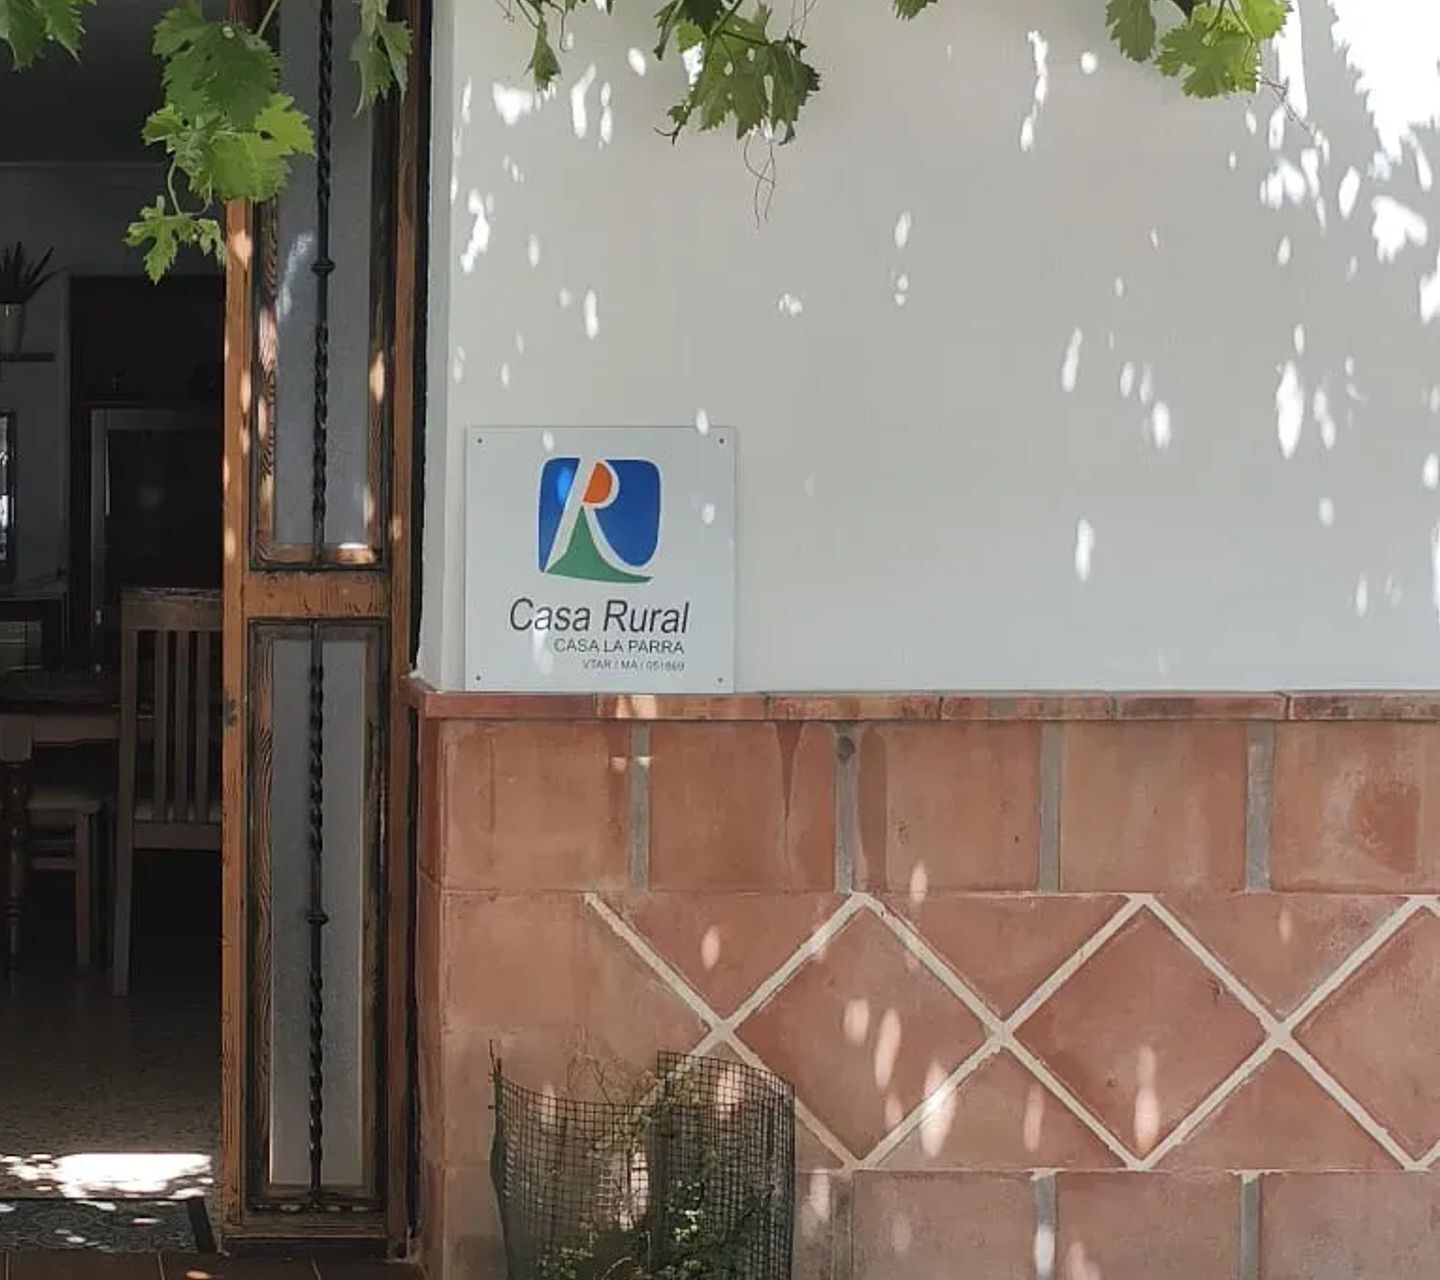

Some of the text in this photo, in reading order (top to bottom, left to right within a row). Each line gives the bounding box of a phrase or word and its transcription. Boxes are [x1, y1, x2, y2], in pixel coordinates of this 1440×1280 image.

[509, 597, 690, 634] Casa Rural
[553, 638, 685, 655] CASA LA PARRA
[582, 659, 611, 670] VTAR
[621, 660, 638, 671] MA
